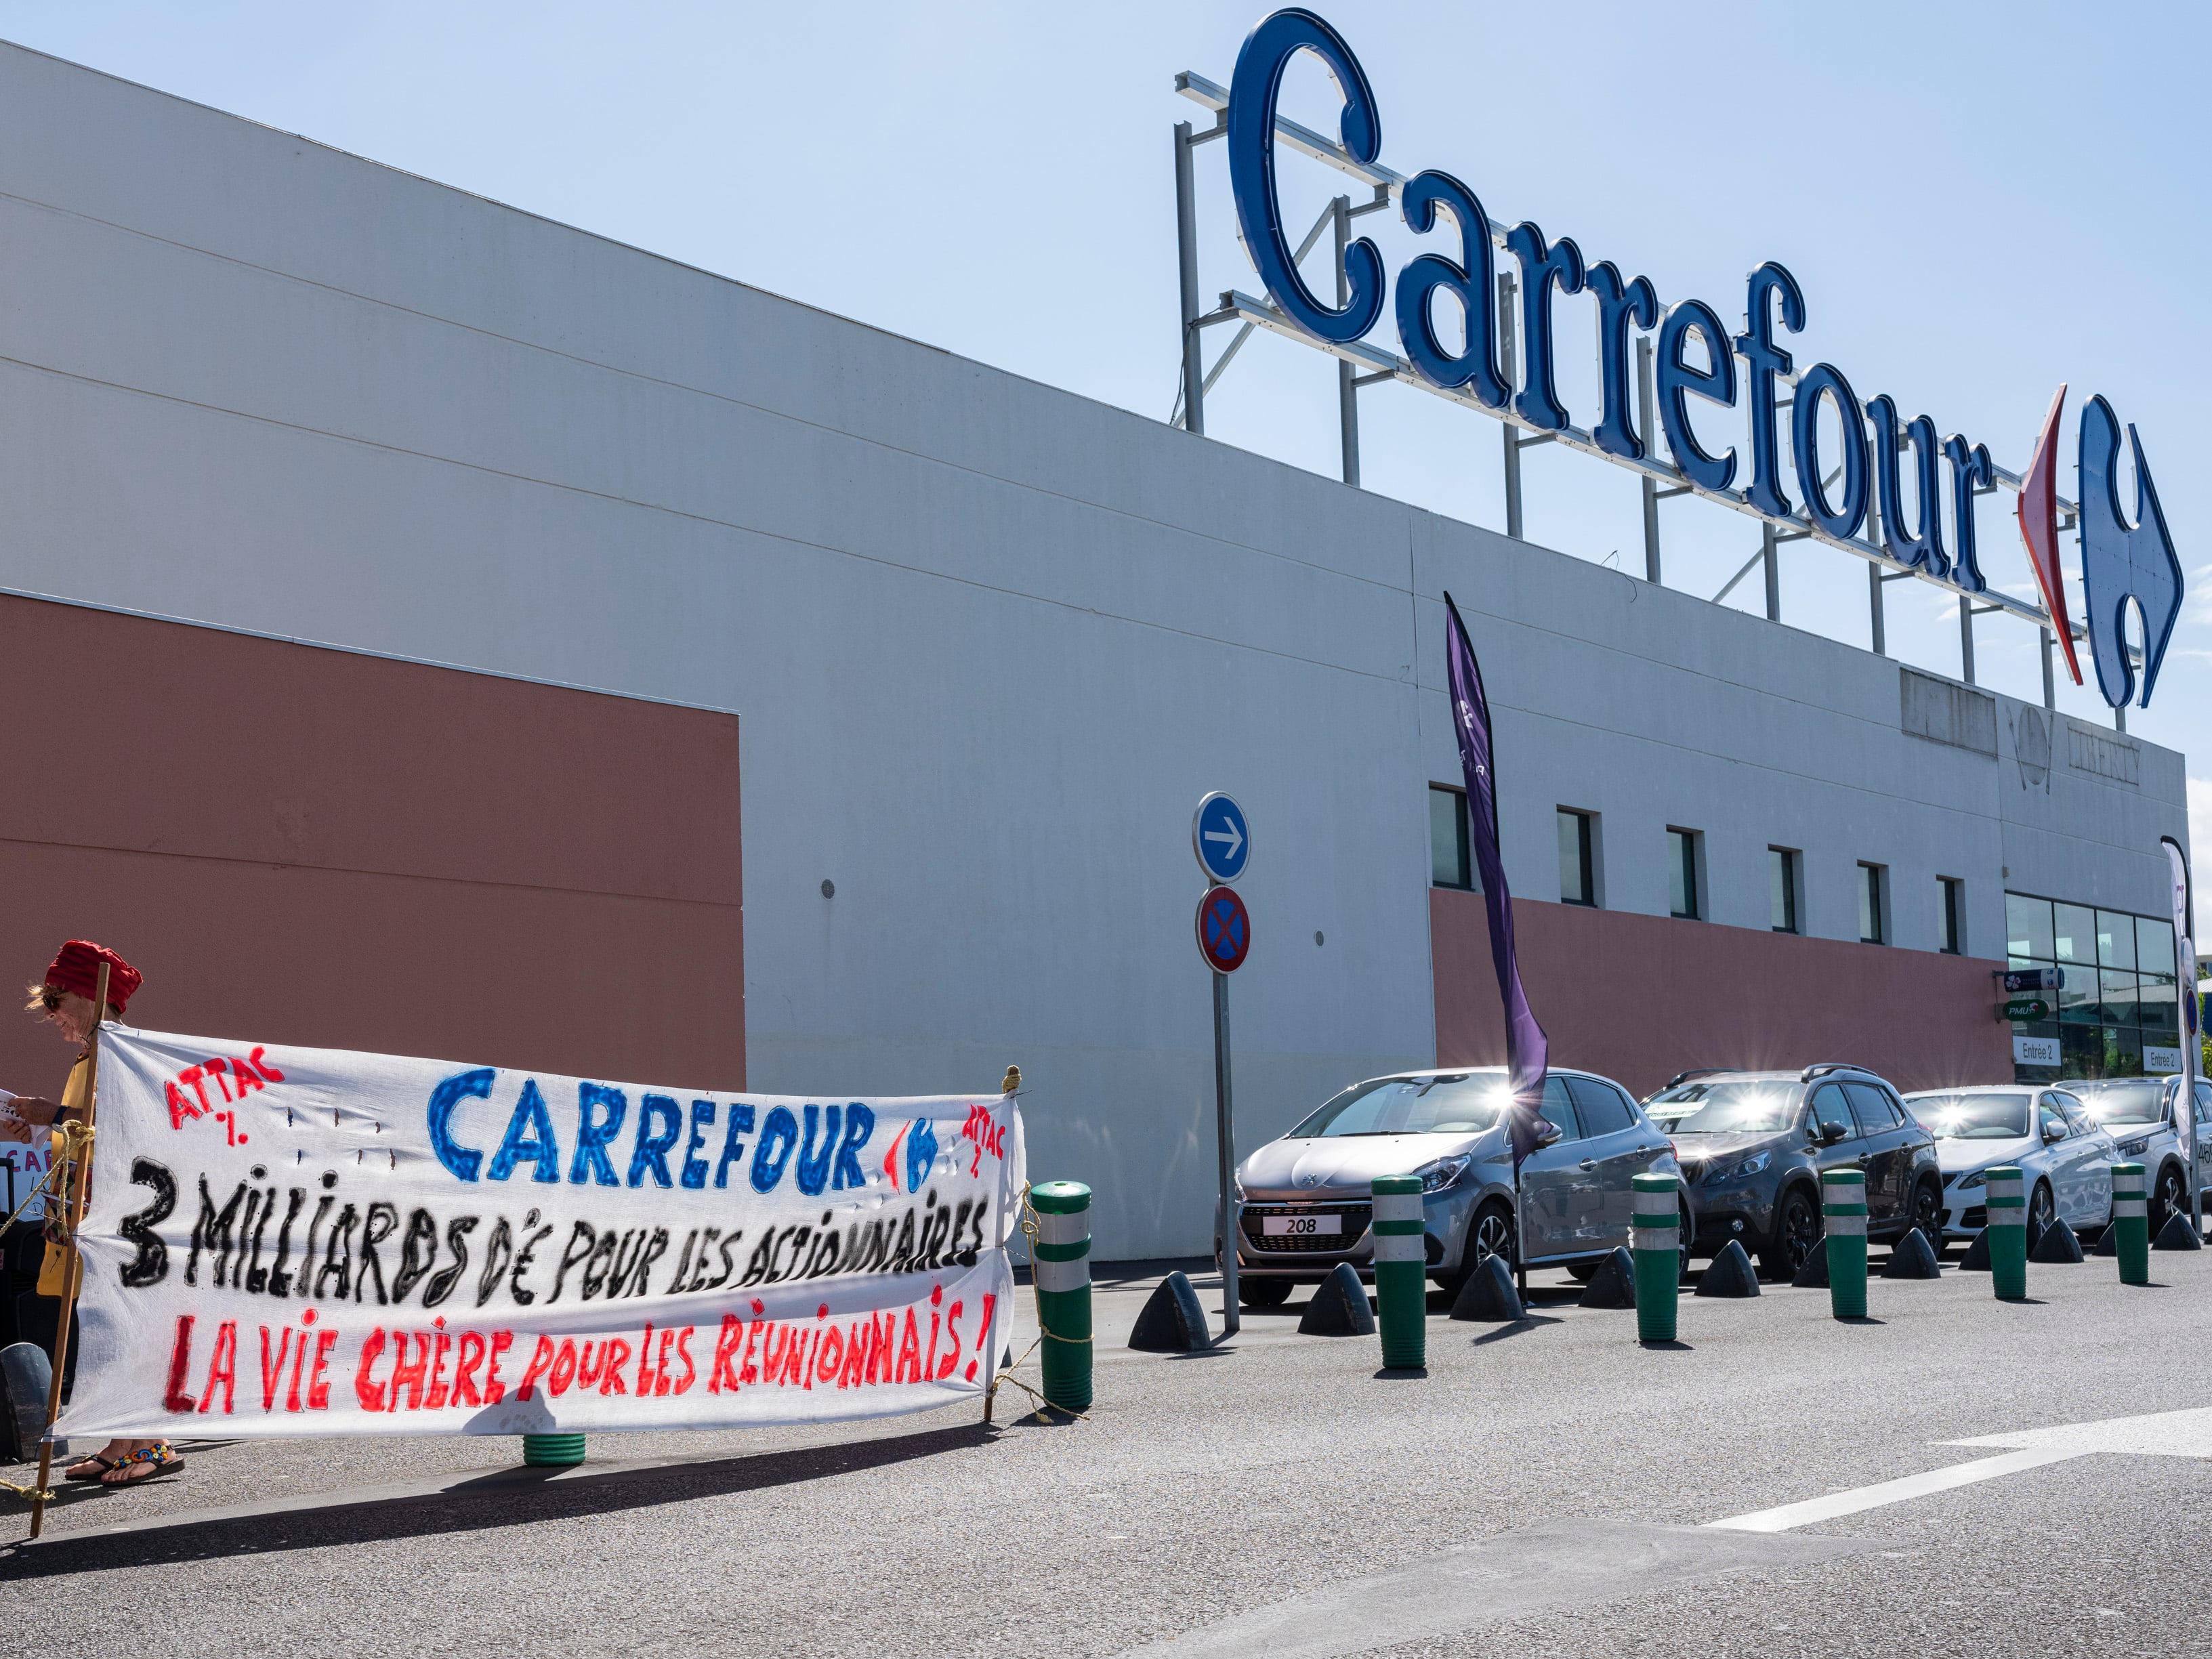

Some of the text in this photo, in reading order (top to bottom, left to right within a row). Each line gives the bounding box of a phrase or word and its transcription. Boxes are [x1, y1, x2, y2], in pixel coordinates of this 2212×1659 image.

[1228, 7, 1991, 593] Carrefour
[2009, 1007, 2030, 1015] PMU
[2023, 1043, 2052, 1059] Entrée 2
[2151, 1052, 2175, 1067] Entrée 2
[164, 1045, 286, 1130] ATTAC
[427, 1067, 875, 1196] CARREFOUR
[962, 1104, 1005, 1160] ATTAC
[117, 1156, 179, 1288] 3
[544, 1219, 669, 1305] POUR
[663, 1227, 743, 1295] LES
[1287, 1219, 1316, 1234] 208
[162, 1314, 237, 1414] LA
[516, 1333, 630, 1401] POUR
[635, 1321, 696, 1398] LES
